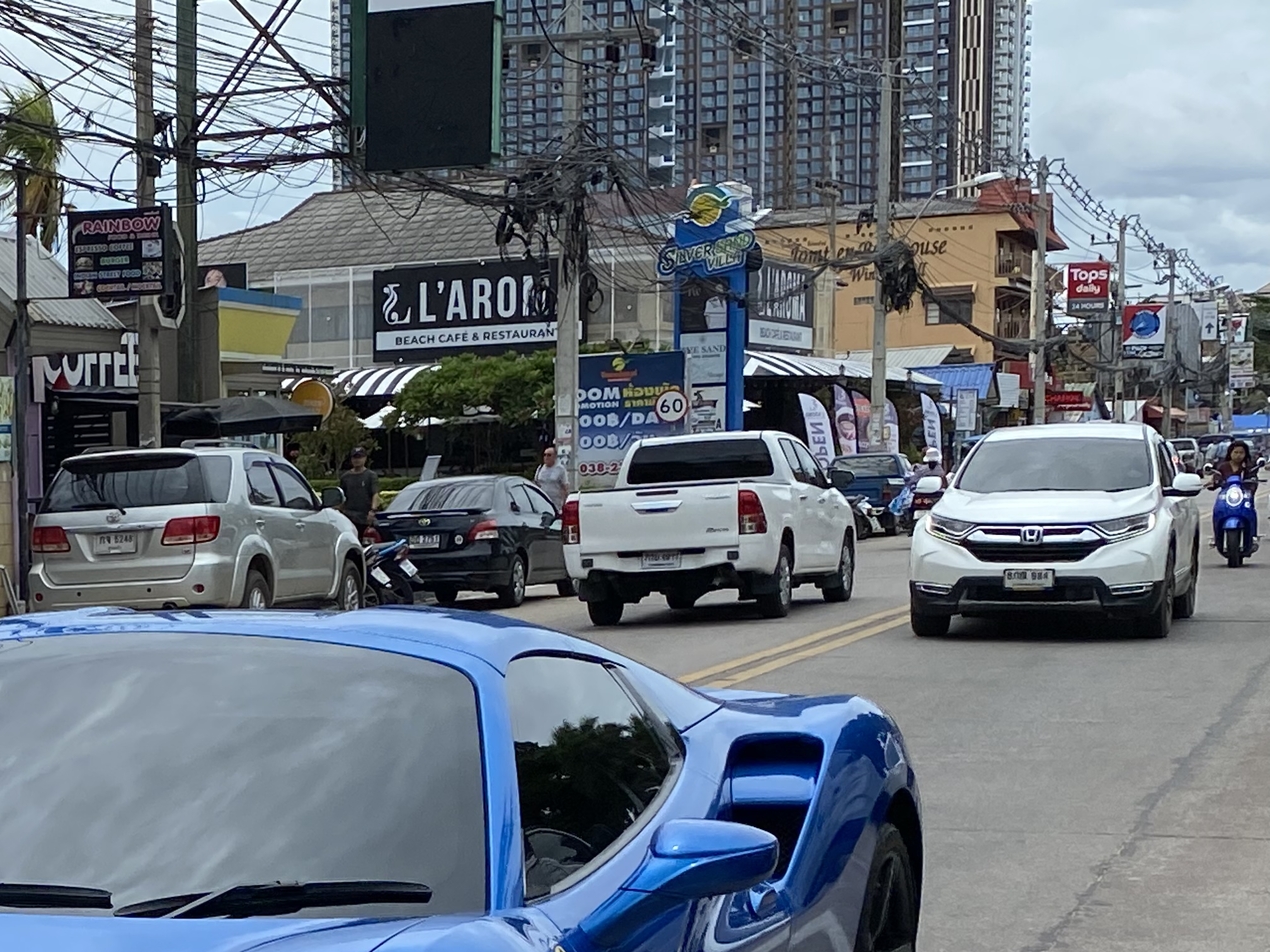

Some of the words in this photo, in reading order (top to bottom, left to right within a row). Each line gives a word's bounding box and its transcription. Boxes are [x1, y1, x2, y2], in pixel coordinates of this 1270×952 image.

[82, 216, 161, 235] RAINBOW
[1070, 268, 1109, 284] Tops
[1075, 283, 1101, 295] daily
[395, 330, 435, 346] BEACH
[438, 329, 469, 344] CAFÉ
[472, 332, 480, 342] &
[577, 386, 621, 402] OOM
[659, 398, 683, 414] 60
